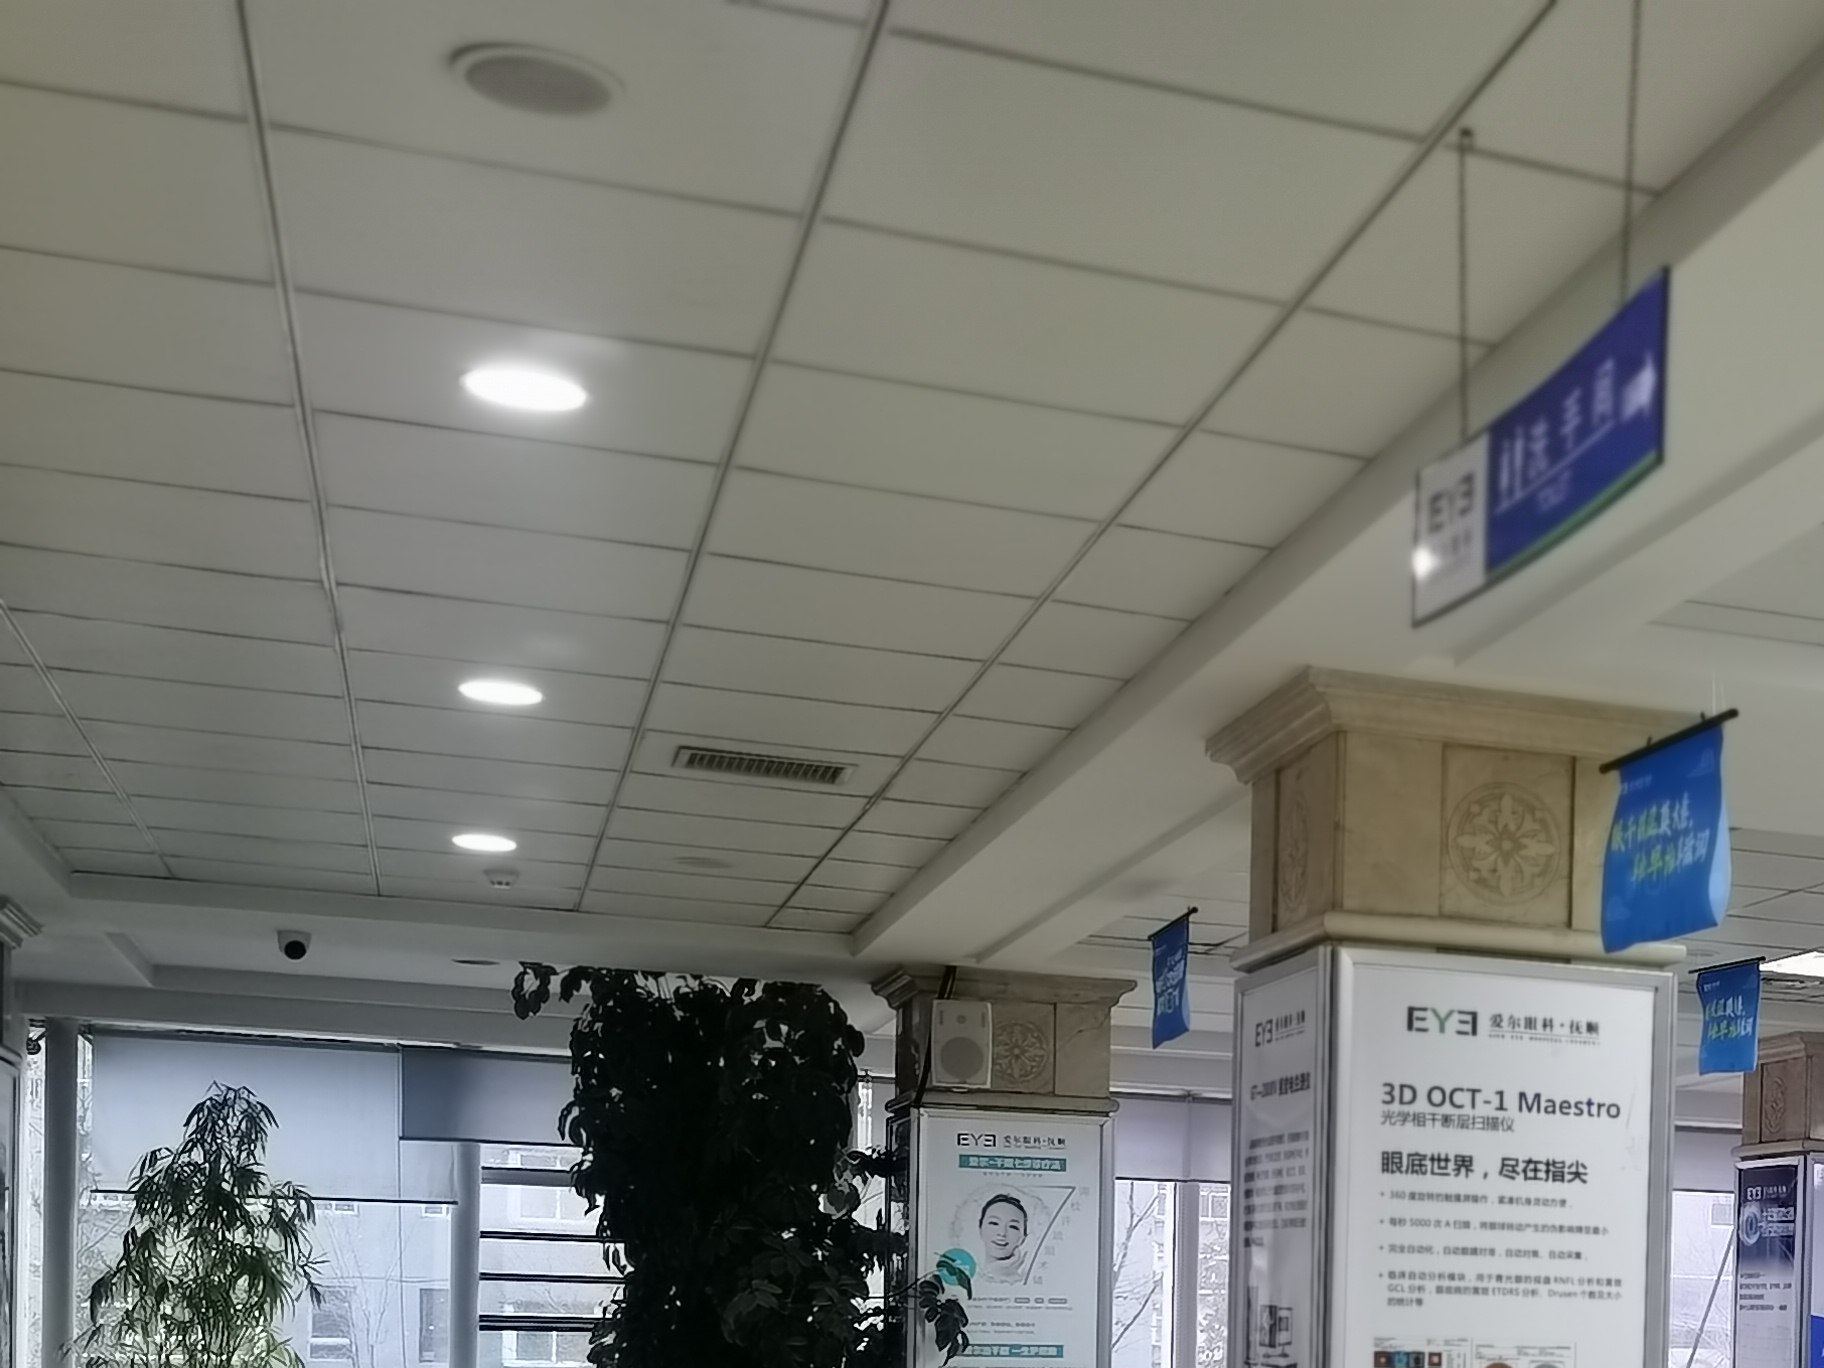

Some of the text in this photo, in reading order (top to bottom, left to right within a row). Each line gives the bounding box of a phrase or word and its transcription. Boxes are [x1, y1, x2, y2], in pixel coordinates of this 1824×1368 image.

[1381, 1083, 1621, 1119] 3D OCT-1 Maestro
[1381, 1151, 1589, 1184] 眼底世界，尽在指尖
